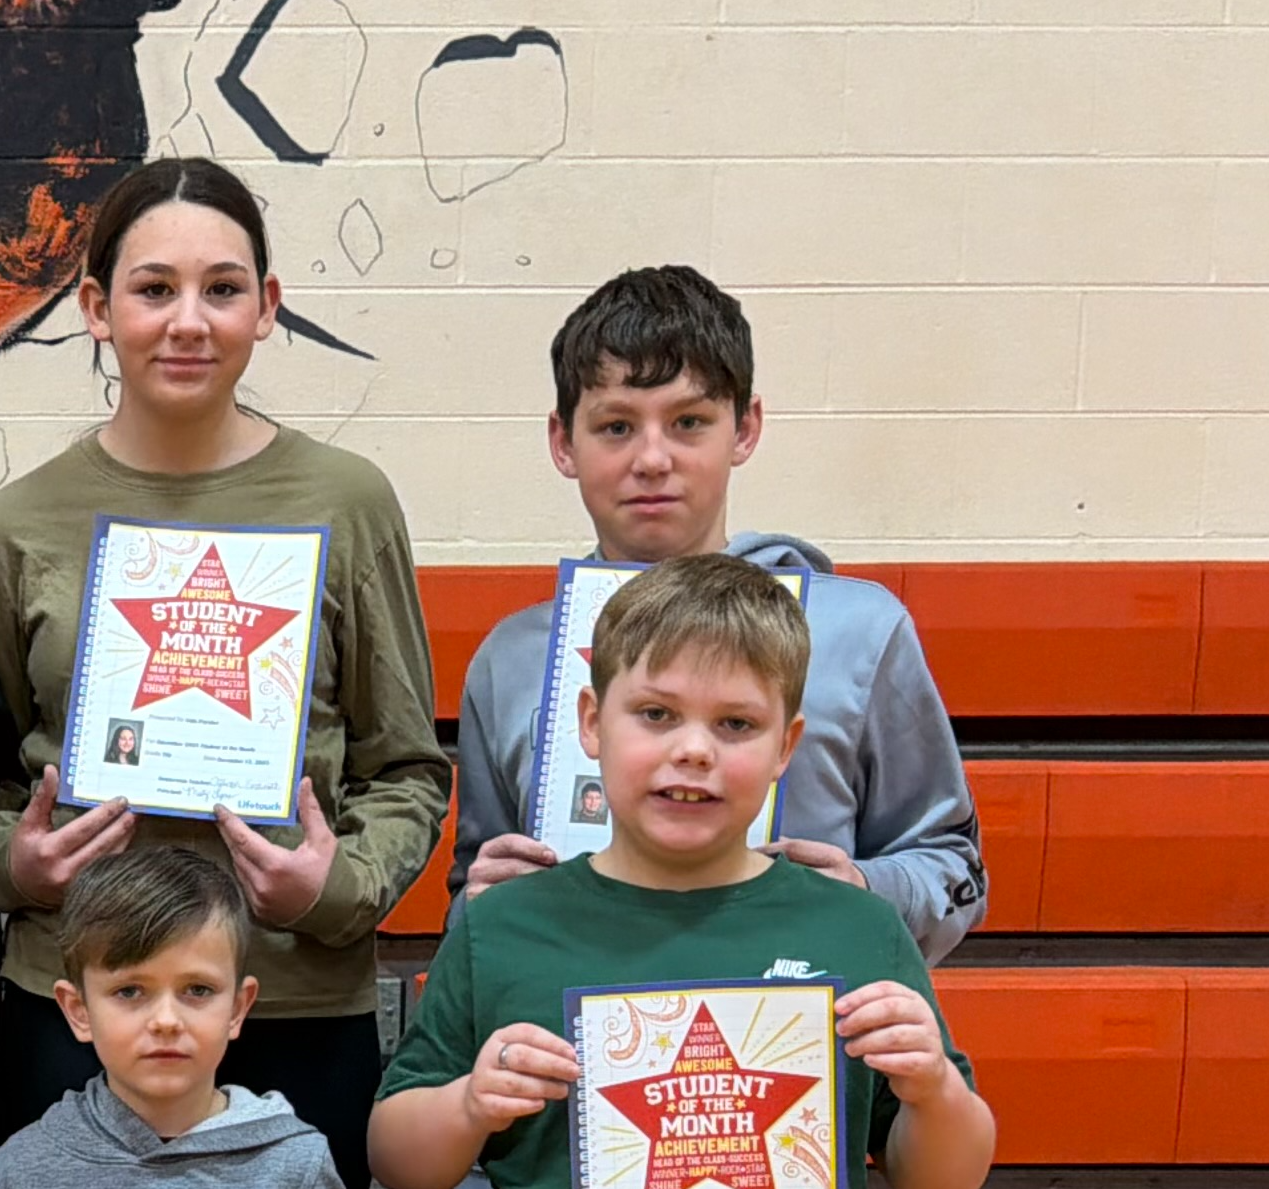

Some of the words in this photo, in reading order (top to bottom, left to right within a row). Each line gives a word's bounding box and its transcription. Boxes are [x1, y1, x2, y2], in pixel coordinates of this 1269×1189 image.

[190, 576, 226, 588] BRIGHT
[180, 587, 230, 600] AWESOME
[152, 601, 262, 626] STUDENT
[178, 620, 196, 631] OF
[199, 621, 227, 633] THE
[159, 631, 242, 653] MONTH
[151, 650, 244, 669] ACHIEVEMENT
[237, 800, 281, 811] Lifetouch
[772, 958, 811, 978] NIKE
[691, 1022, 714, 1032] STAR
[684, 1044, 725, 1057] BRIGHT
[675, 1058, 733, 1073] AWESOME
[643, 1073, 772, 1105] STUDENT
[678, 1099, 698, 1113] OF
[701, 1097, 734, 1112] THE
[660, 1112, 754, 1138] MONTH
[654, 1135, 759, 1157] ACHIEVEMENT
[731, 1175, 770, 1187] SWEET
